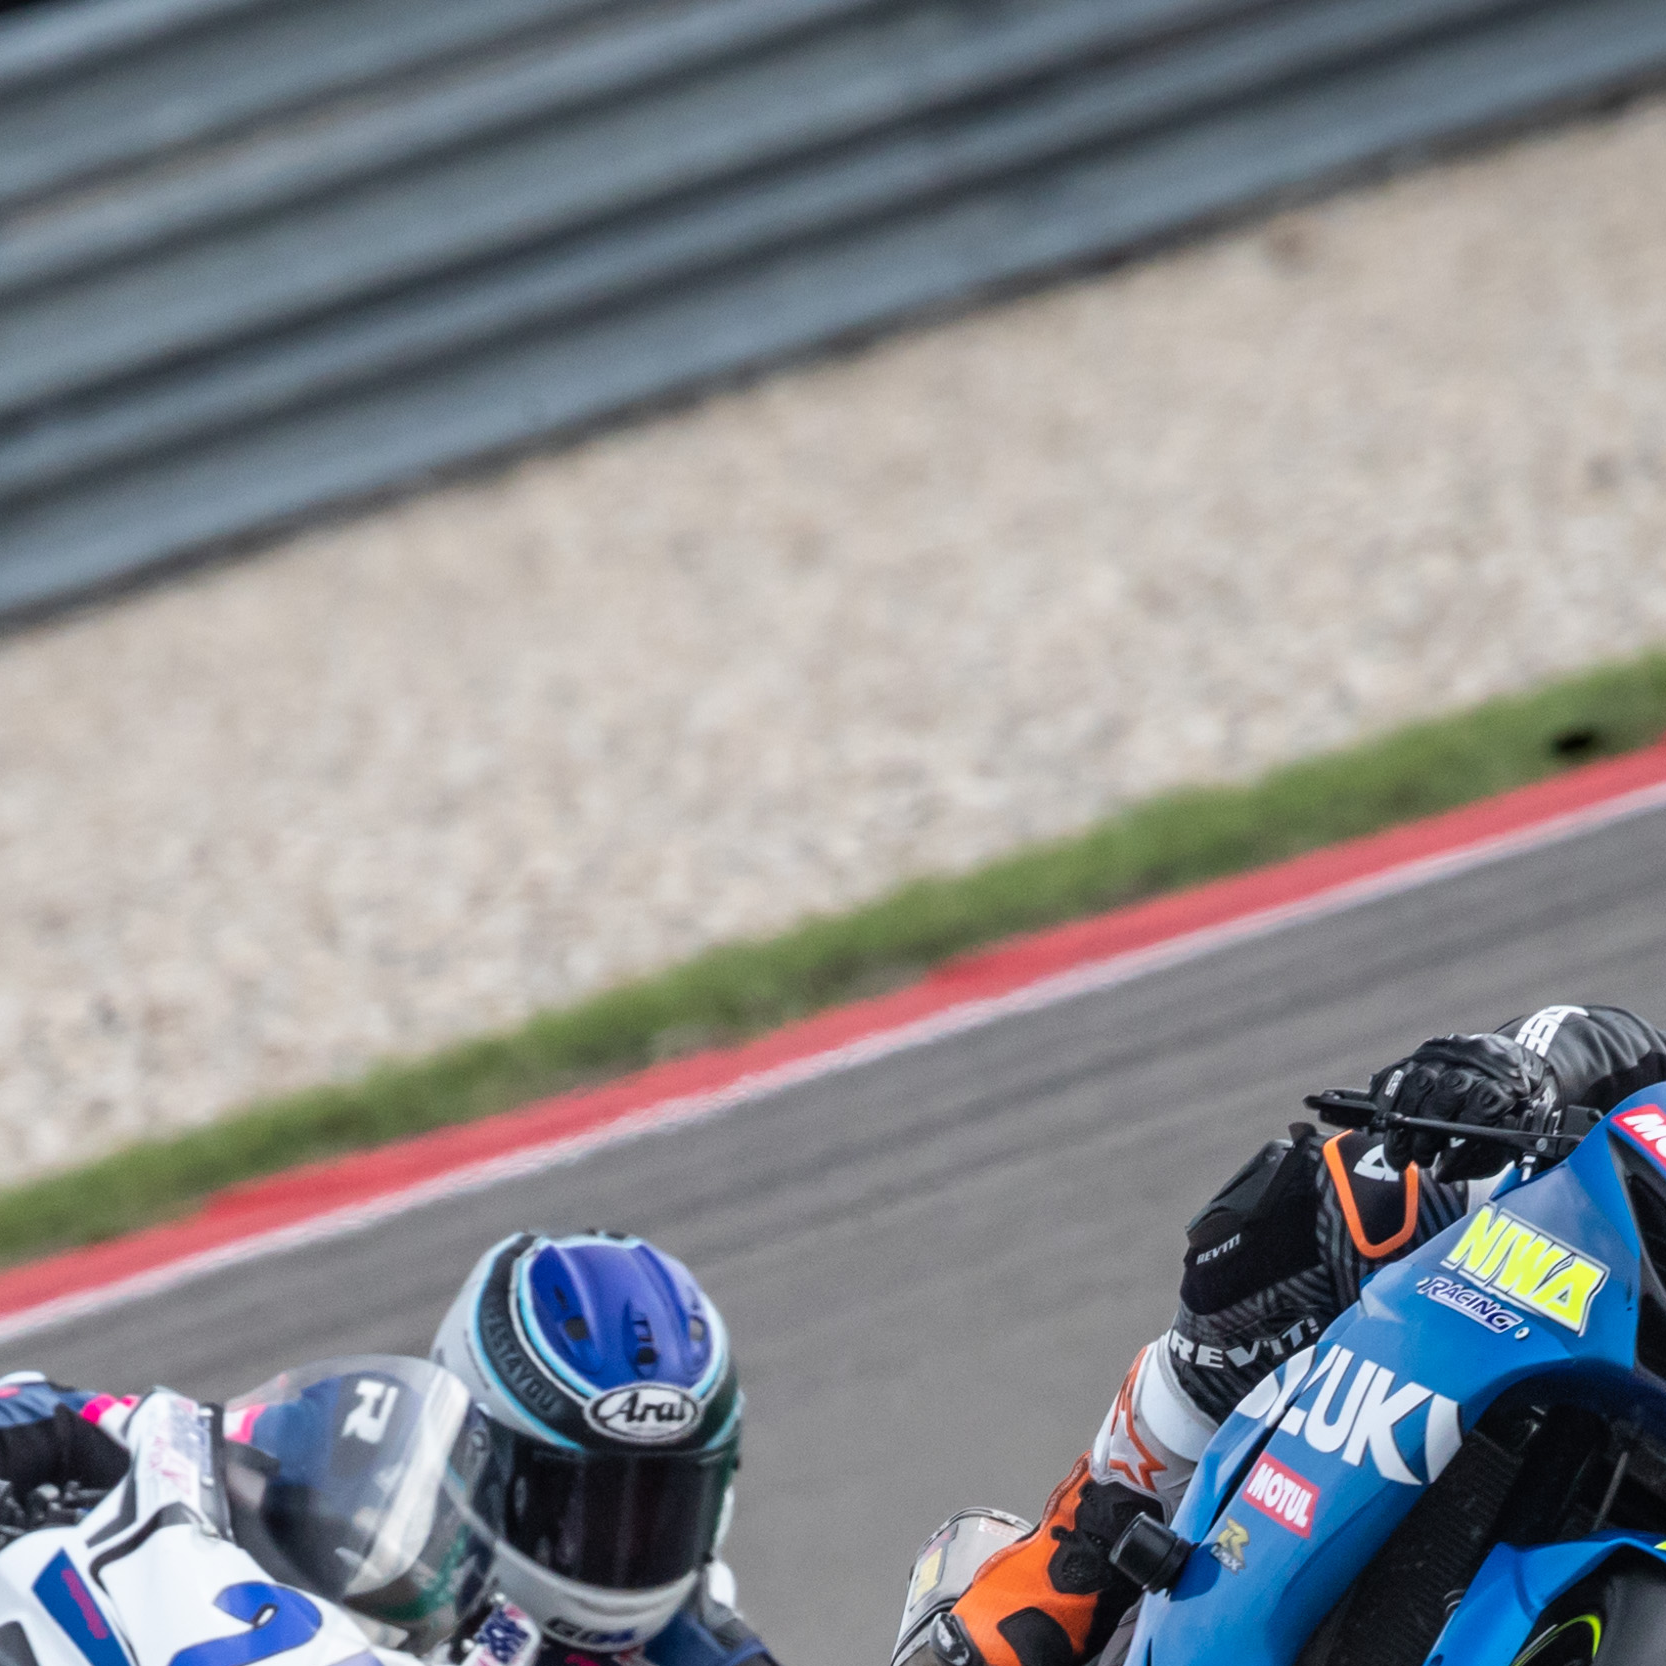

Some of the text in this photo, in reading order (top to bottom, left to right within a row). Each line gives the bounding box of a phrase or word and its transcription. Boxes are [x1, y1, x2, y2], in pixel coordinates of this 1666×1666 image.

[1445, 1204, 1607, 1334] NIWA
[1423, 1278, 1523, 1333] RACING
[599, 1391, 679, 1424] Arai
[1246, 1462, 1314, 1529] MOTUL
